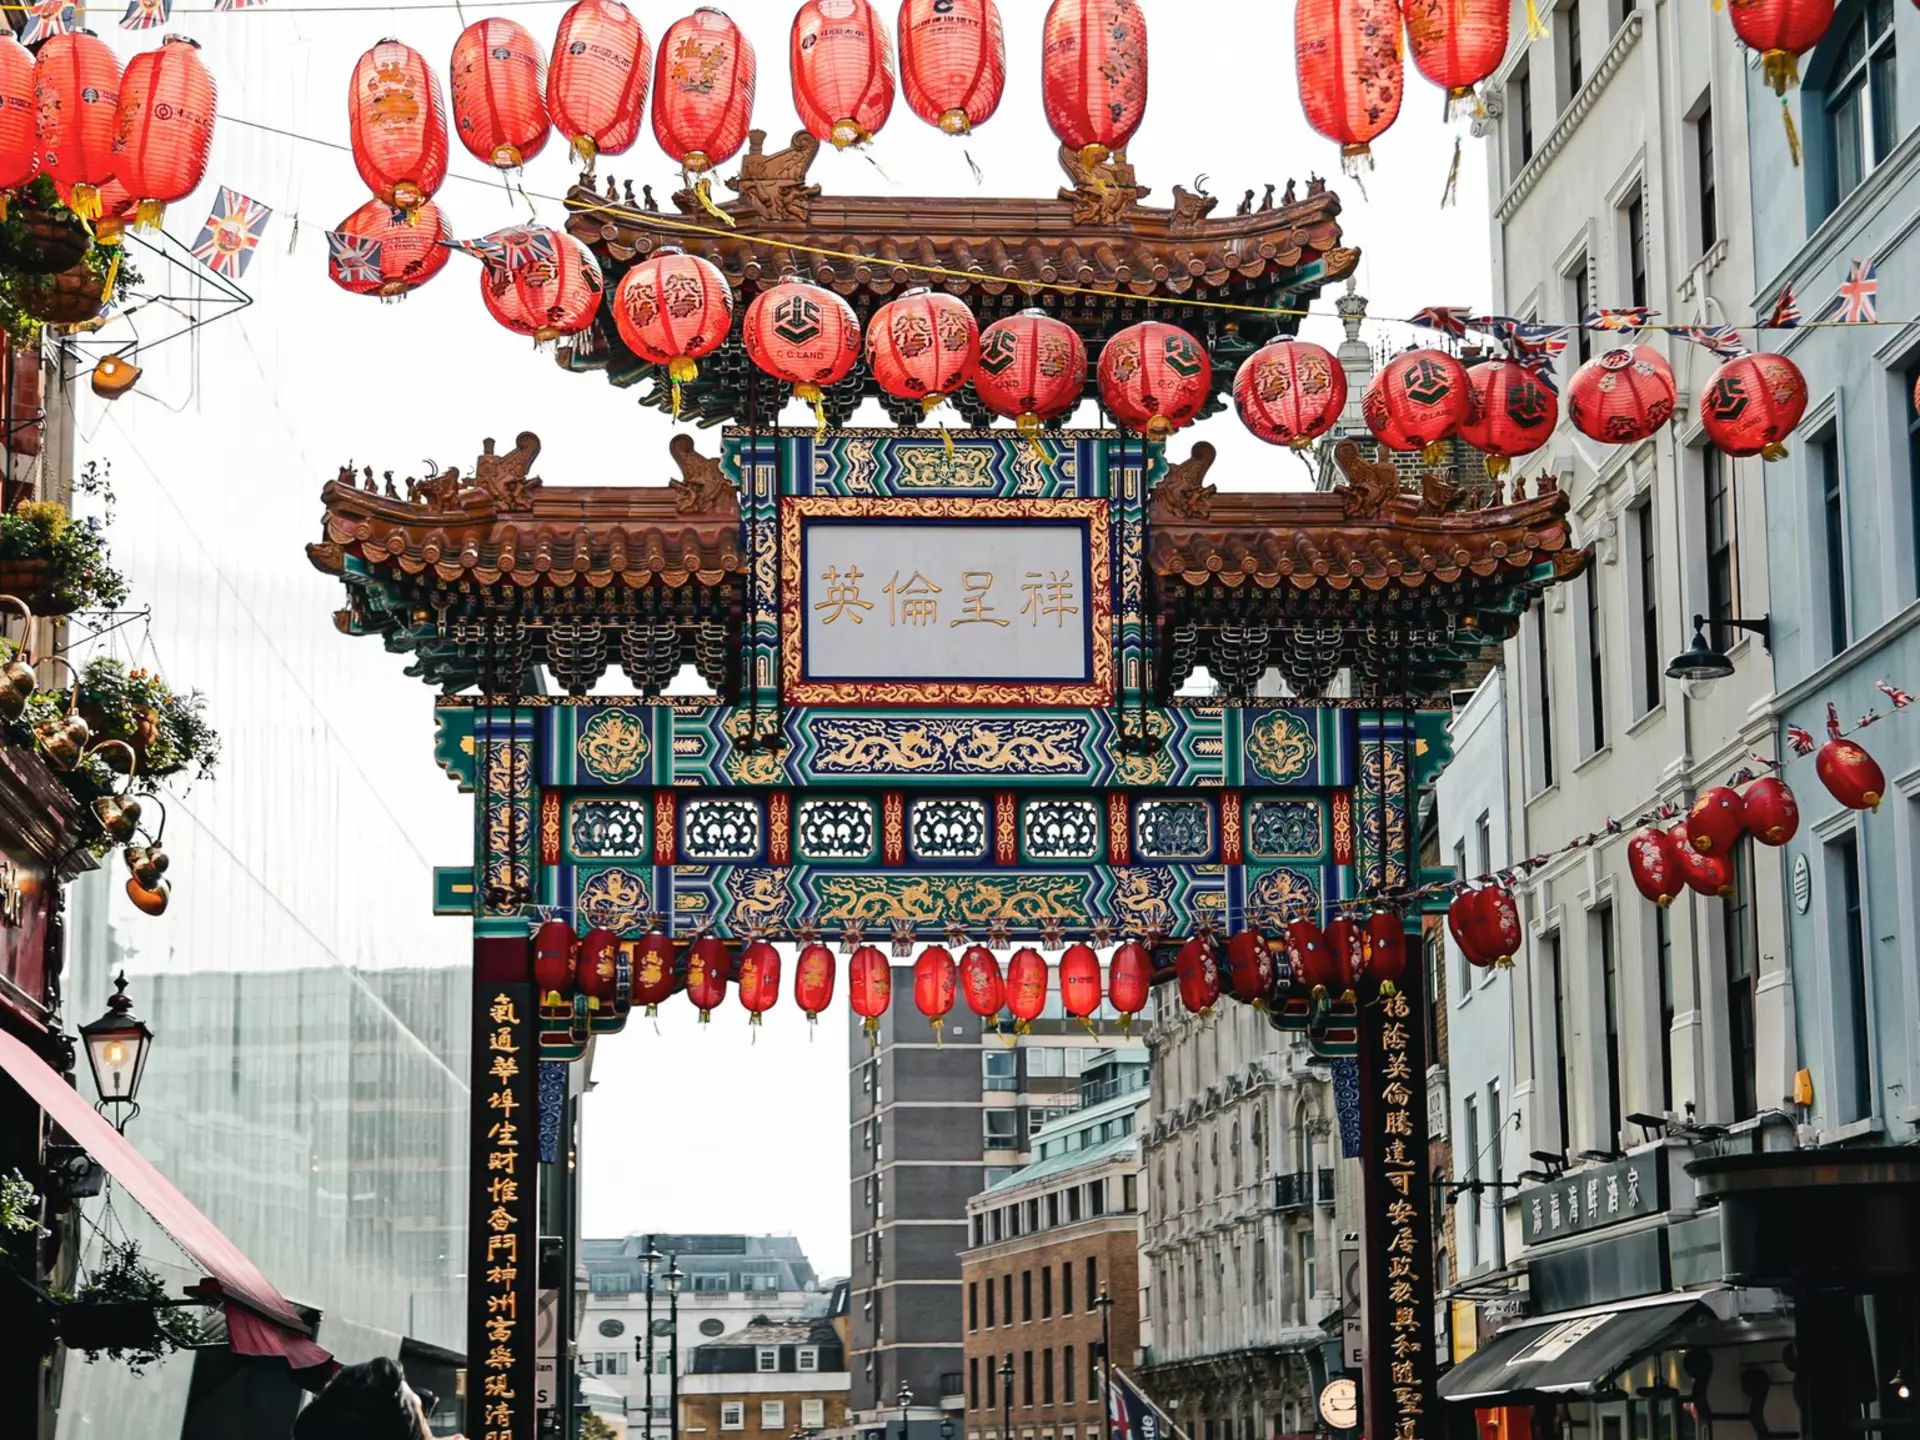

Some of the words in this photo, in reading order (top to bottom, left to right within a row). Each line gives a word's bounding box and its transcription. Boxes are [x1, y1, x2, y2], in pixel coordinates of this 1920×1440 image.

[796, 351, 824, 360] LAND
[814, 564, 1079, 627] 英倫呈祥
